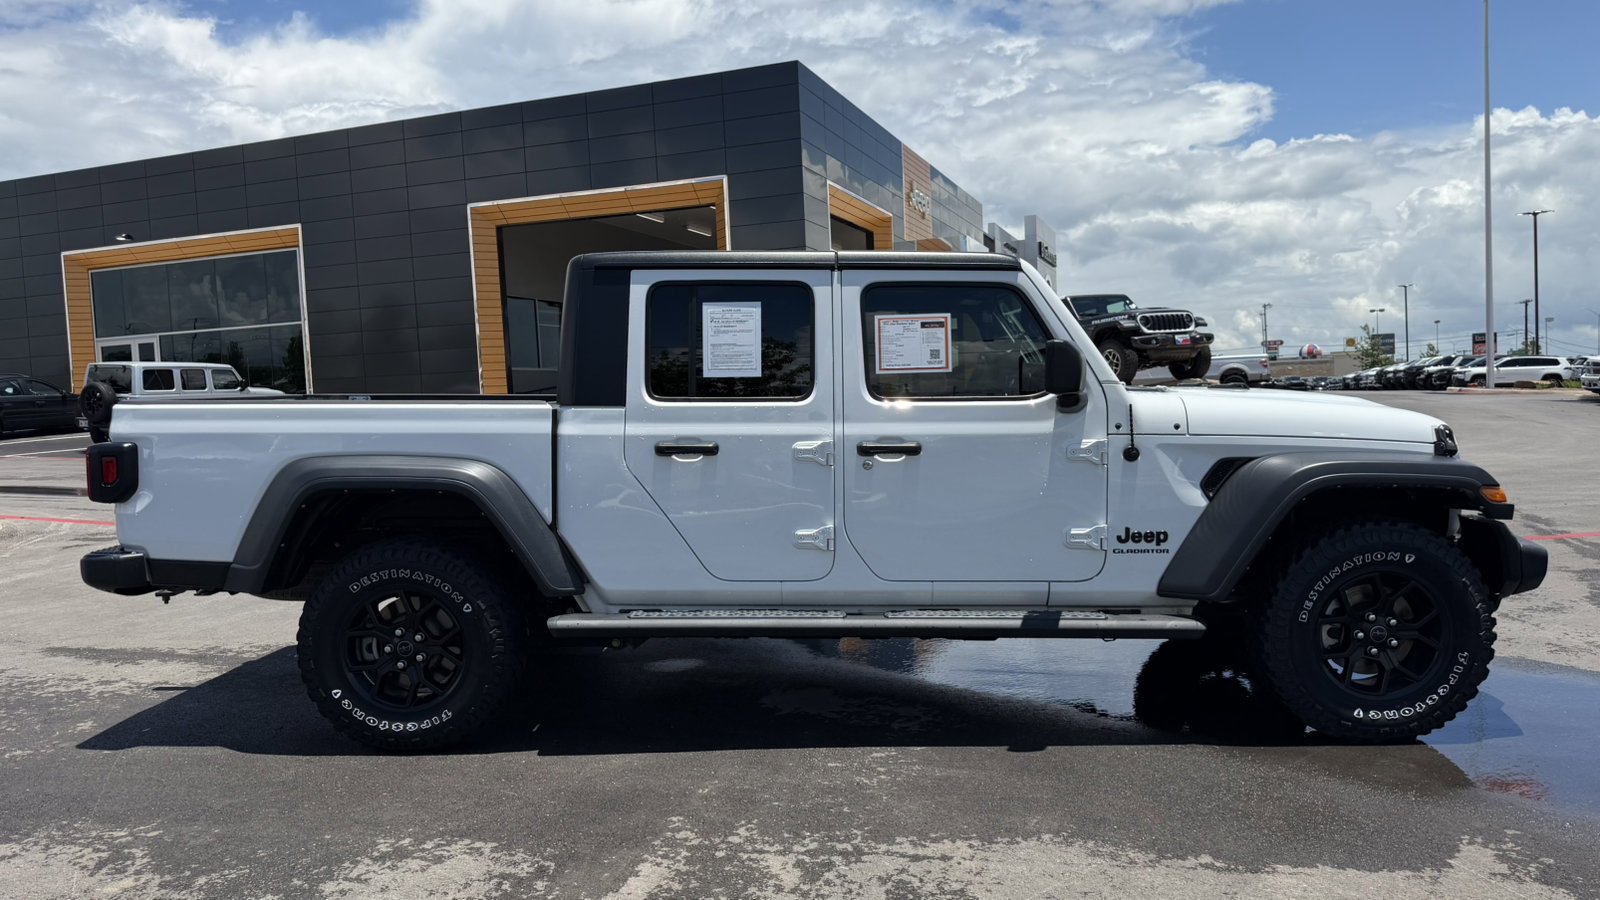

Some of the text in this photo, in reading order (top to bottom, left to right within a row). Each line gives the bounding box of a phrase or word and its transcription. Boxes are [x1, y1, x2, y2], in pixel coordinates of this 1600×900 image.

[1116, 526, 1169, 546] Jeep
[348, 568, 464, 603] DESTINATION
[1298, 551, 1401, 623] DESTINATION
